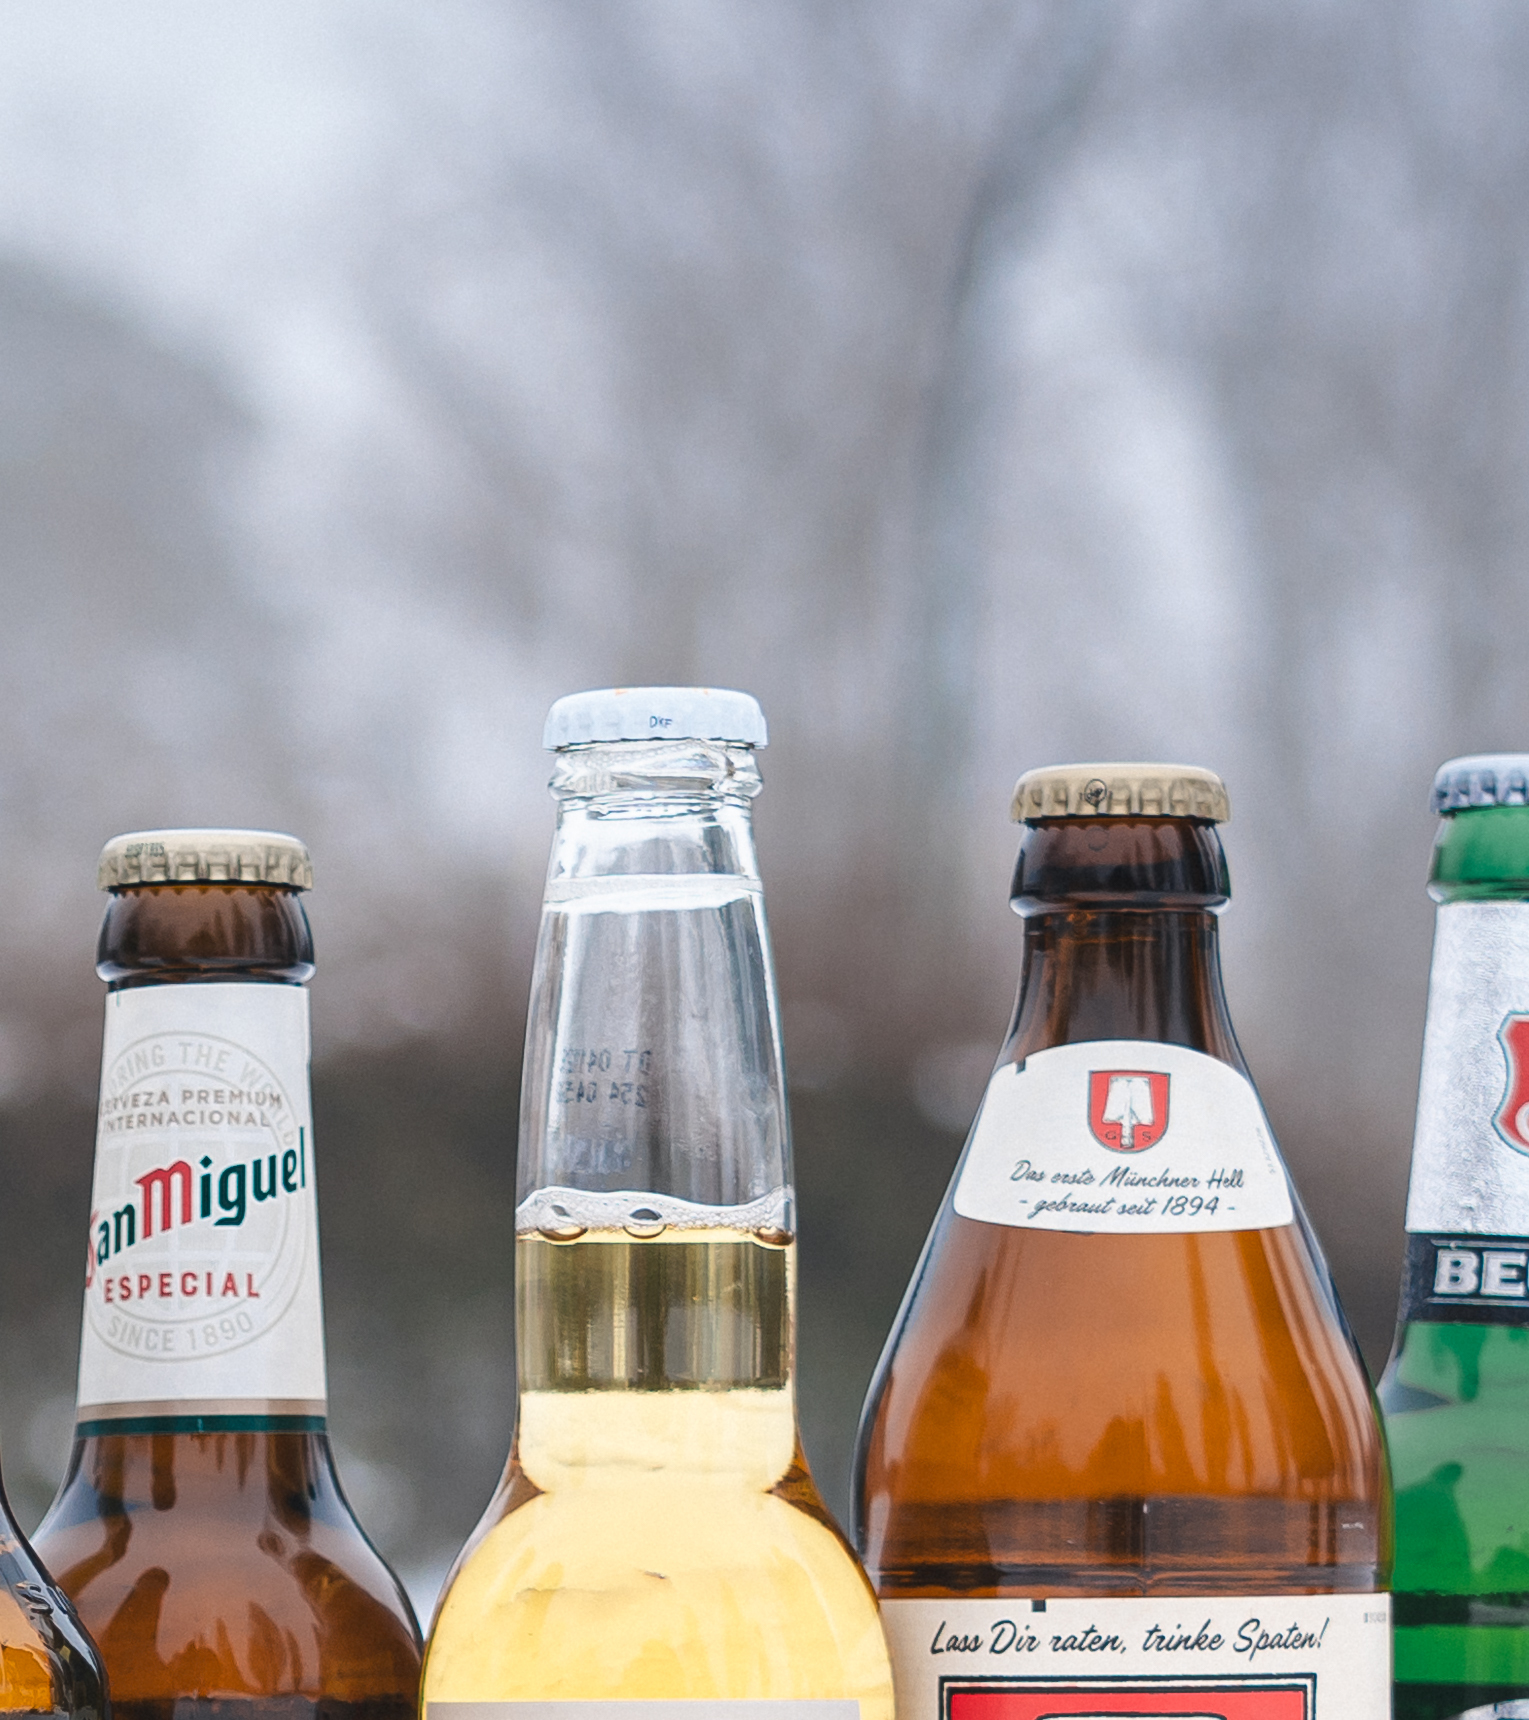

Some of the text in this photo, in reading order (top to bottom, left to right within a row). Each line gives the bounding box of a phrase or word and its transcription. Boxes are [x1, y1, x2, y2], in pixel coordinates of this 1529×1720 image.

[1010, 1160, 1245, 1189] Das erste Münchner Hell
[1027, 1192, 1220, 1219] gebraut seit 1894
[104, 1272, 261, 1304] ESPECIAL
[107, 1311, 253, 1352] SINCE 1890
[930, 1616, 1331, 1662] Lass Dir raten, trinke Spaten!
